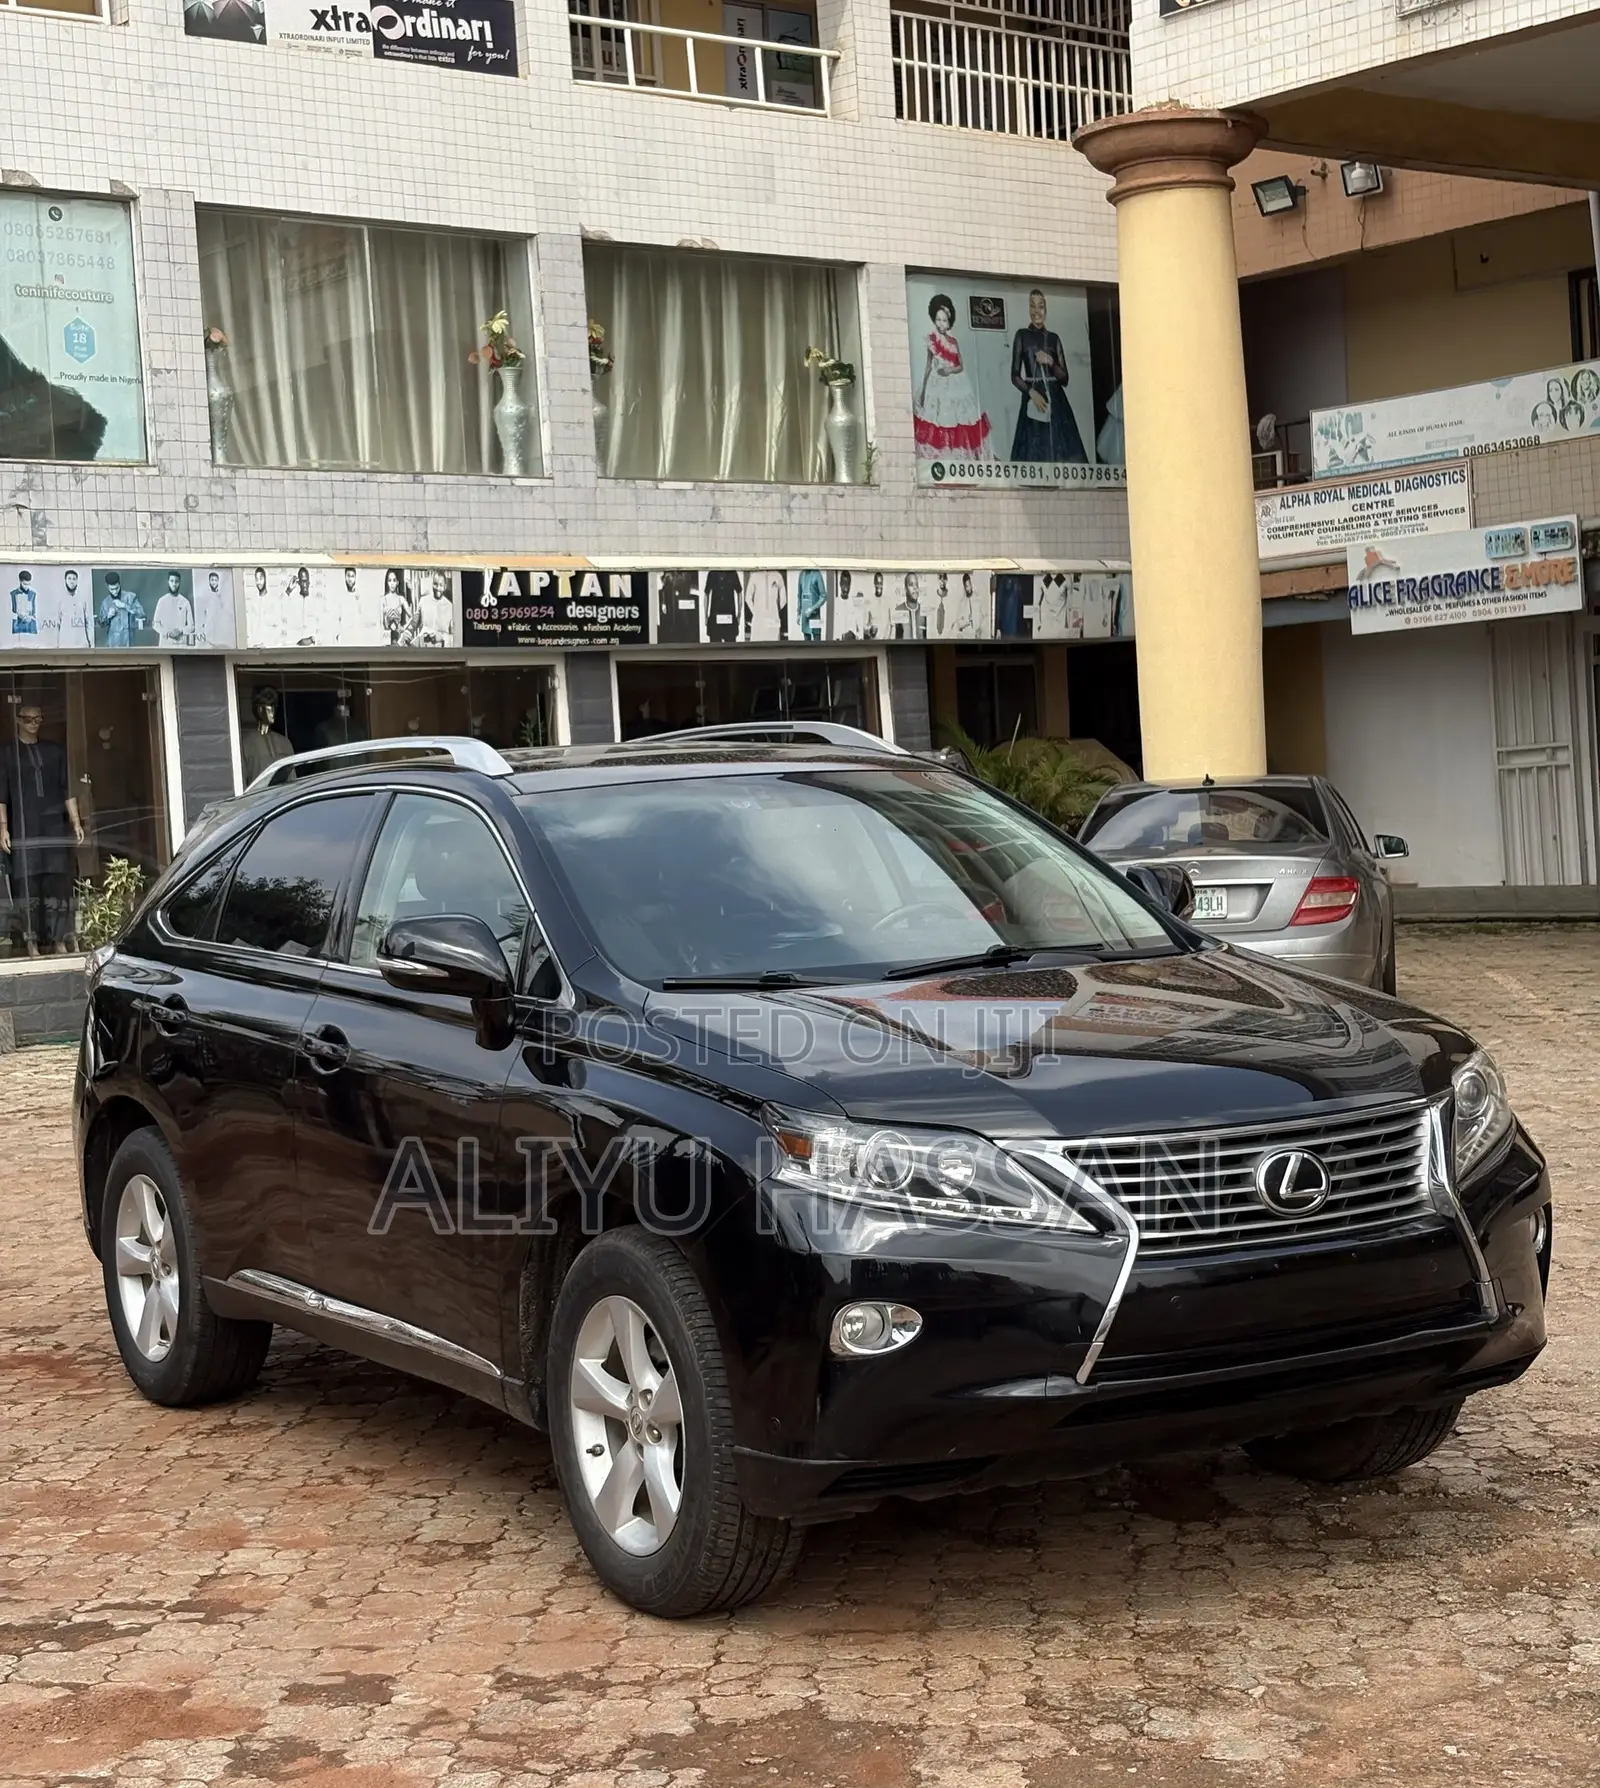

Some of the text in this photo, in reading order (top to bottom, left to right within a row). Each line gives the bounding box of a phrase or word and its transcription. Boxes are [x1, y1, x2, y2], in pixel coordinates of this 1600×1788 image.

[346, 37, 371, 45] LIMITED
[467, 45, 510, 64] for you!
[14, 284, 114, 304] teninifecouture
[72, 333, 87, 344] 18
[89, 374, 109, 383] made
[110, 374, 118, 383] in
[1463, 435, 1541, 457] 08063453068
[950, 464, 1127, 482] 08065267681, 080378654
[1280, 469, 1466, 510] ALPHA ROYAL MEDICAL DIAGNOSTICS
[1352, 498, 1395, 512] CENTRE
[1267, 519, 1335, 534] COMPREHENSIVE
[1338, 510, 1393, 524] LABORATORY
[1396, 503, 1438, 516] SERVICES
[1267, 529, 1315, 541] VOLUNTARY
[1317, 521, 1371, 534] COUNSELING
[1383, 511, 1419, 525] TESTING
[1422, 506, 1466, 519] SERVICES
[1348, 557, 1578, 610] ALICE FRAGRANCE & MORE
[1424, 604, 1432, 612] OF
[1445, 599, 1475, 610] PERFUMES
[1502, 592, 1528, 603] FASHION
[1529, 591, 1547, 599] ITEMS
[567, 602, 640, 622] designers
[473, 622, 502, 632] Tailoring
[613, 623, 642, 633] Academy
[1197, 896, 1224, 912] 43LH
